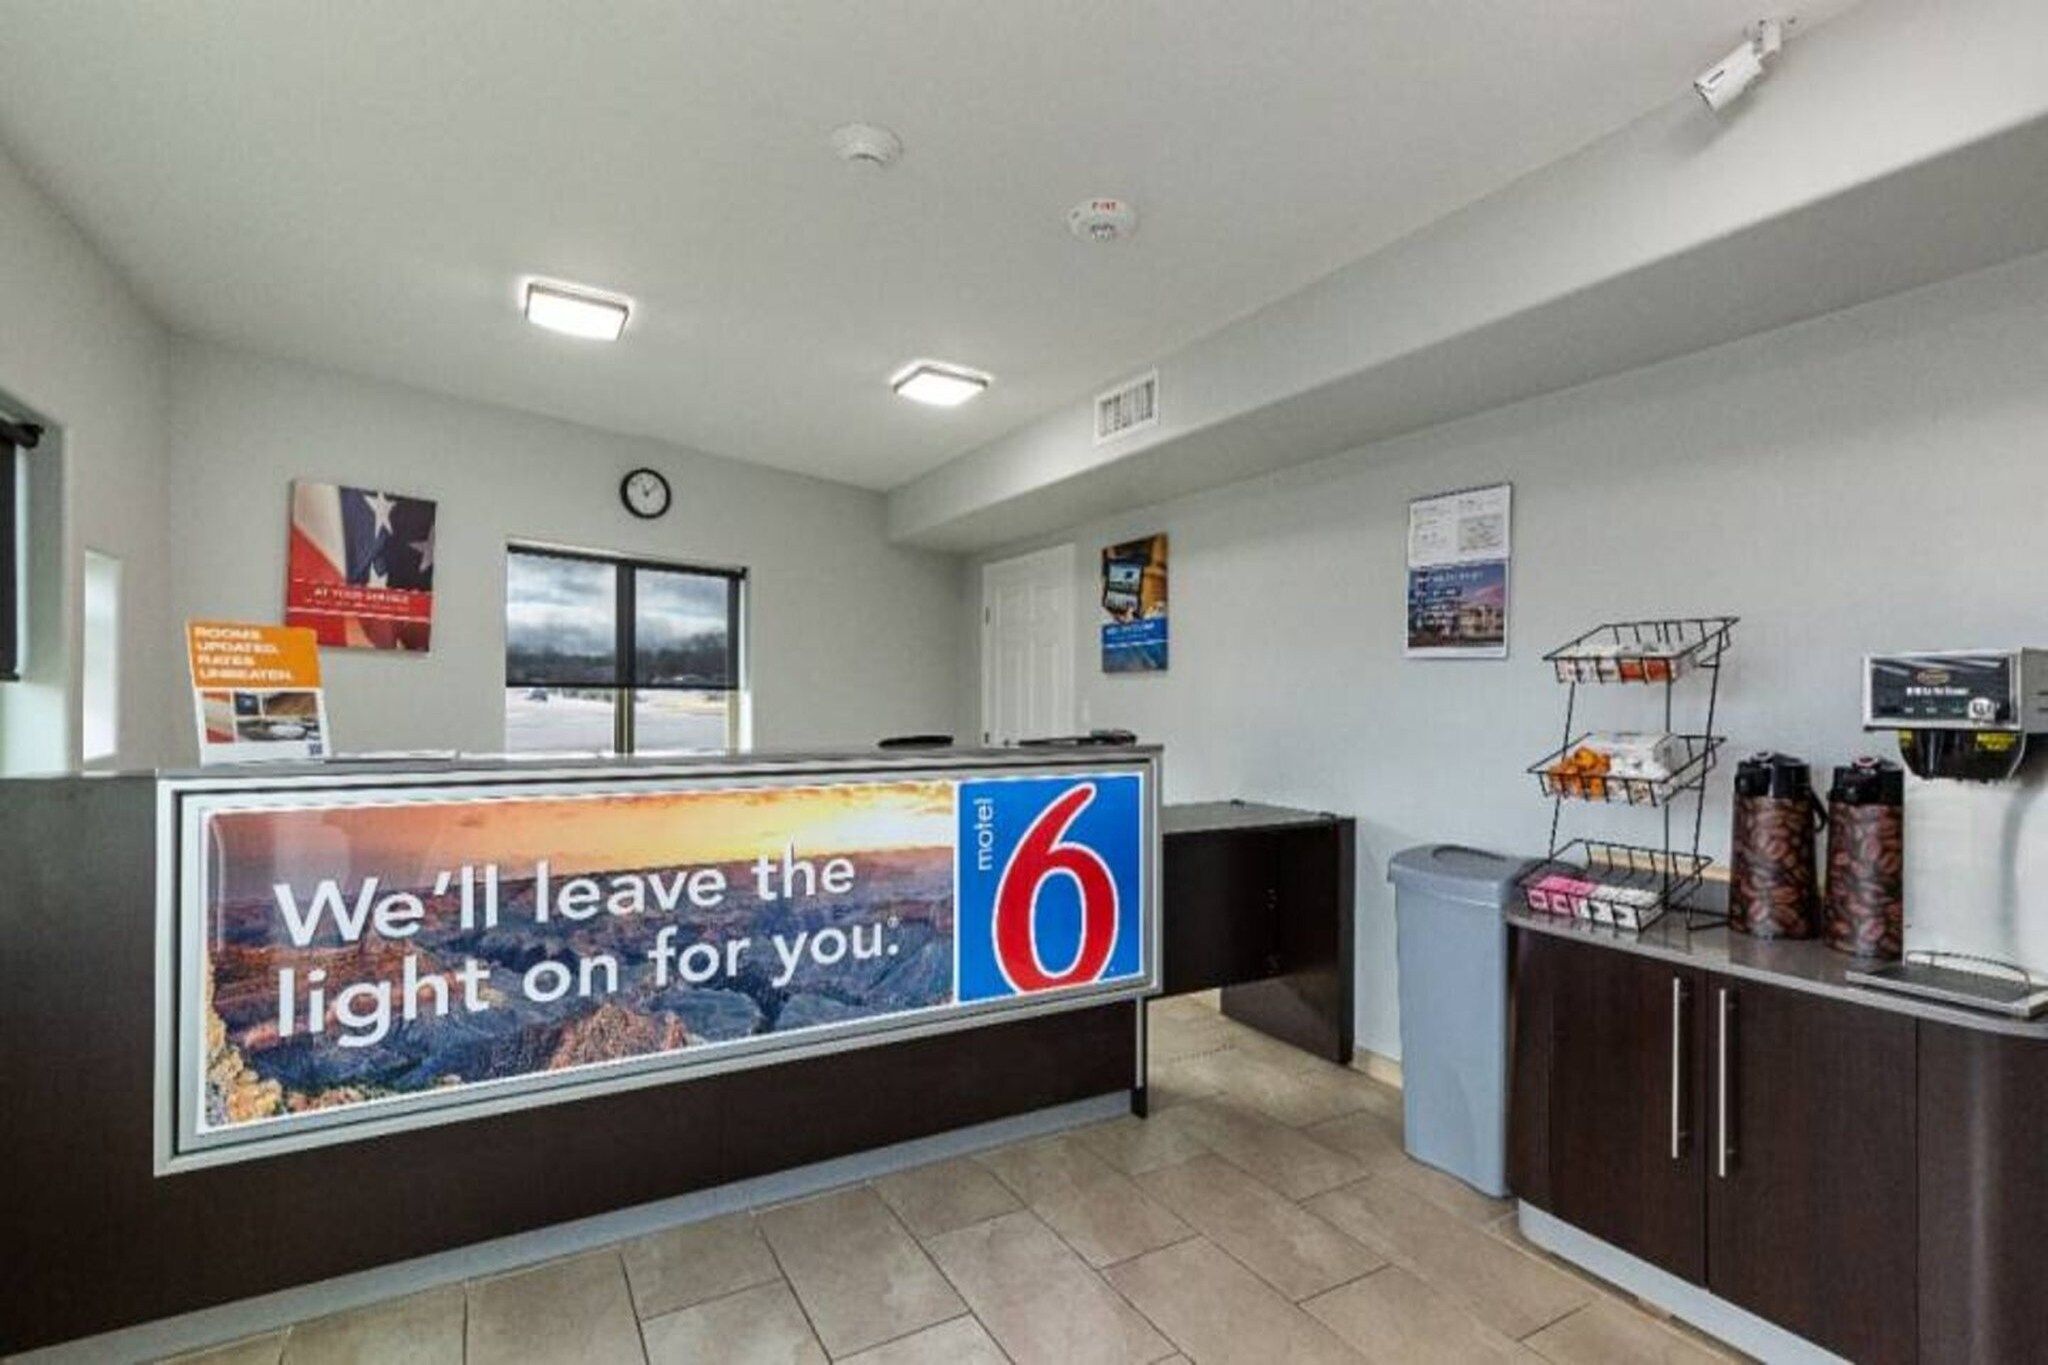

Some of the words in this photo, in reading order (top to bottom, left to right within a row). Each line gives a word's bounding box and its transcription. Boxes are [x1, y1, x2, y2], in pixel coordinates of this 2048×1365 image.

[273, 863, 498, 947] We'll
[536, 859, 726, 924] leave
[752, 836, 855, 901] the
[976, 797, 994, 871] motel
[991, 781, 1119, 997] 6
[278, 955, 491, 1047] light
[523, 953, 618, 1002] on
[649, 925, 751, 988] for
